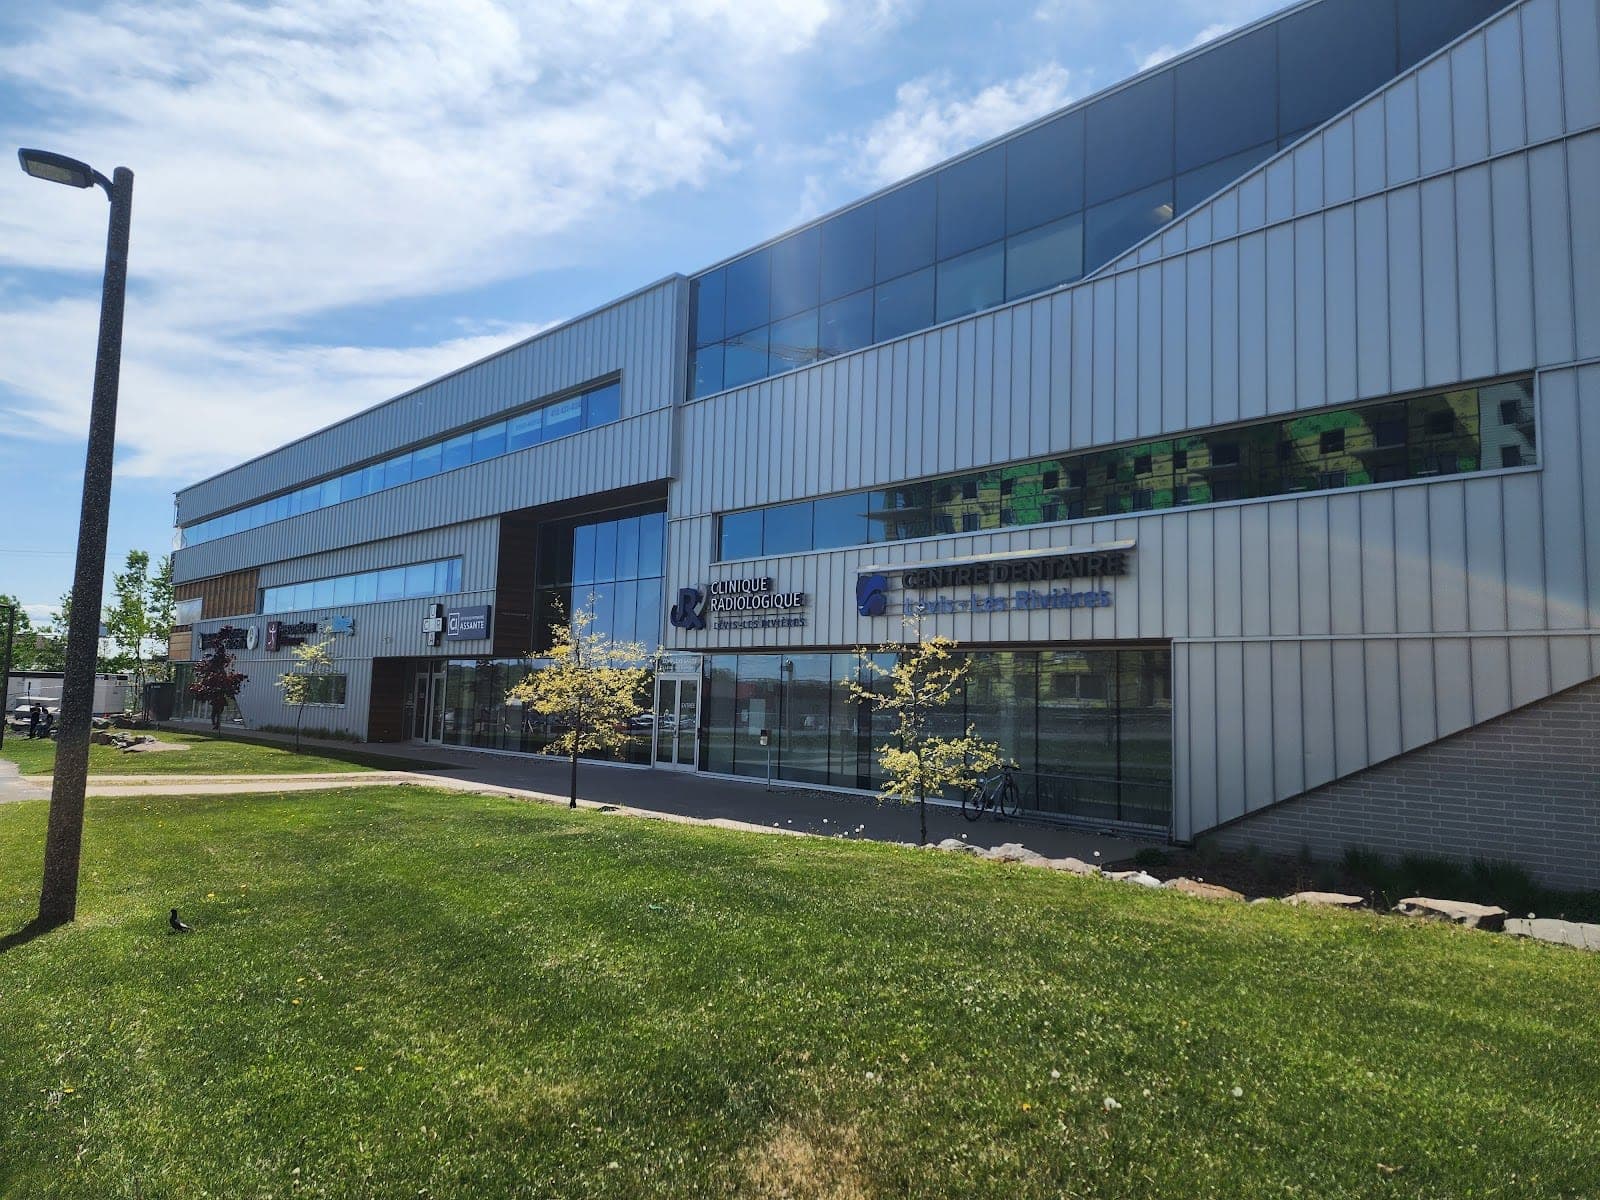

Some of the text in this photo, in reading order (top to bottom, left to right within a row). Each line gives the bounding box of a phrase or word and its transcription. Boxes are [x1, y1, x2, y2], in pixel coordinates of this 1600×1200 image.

[902, 551, 1129, 589] CENTRE DENTAIRE
[711, 577, 769, 594] CLINIQUE
[710, 592, 802, 611] RADIOLOGIQUE
[460, 621, 484, 630] ASSANTE
